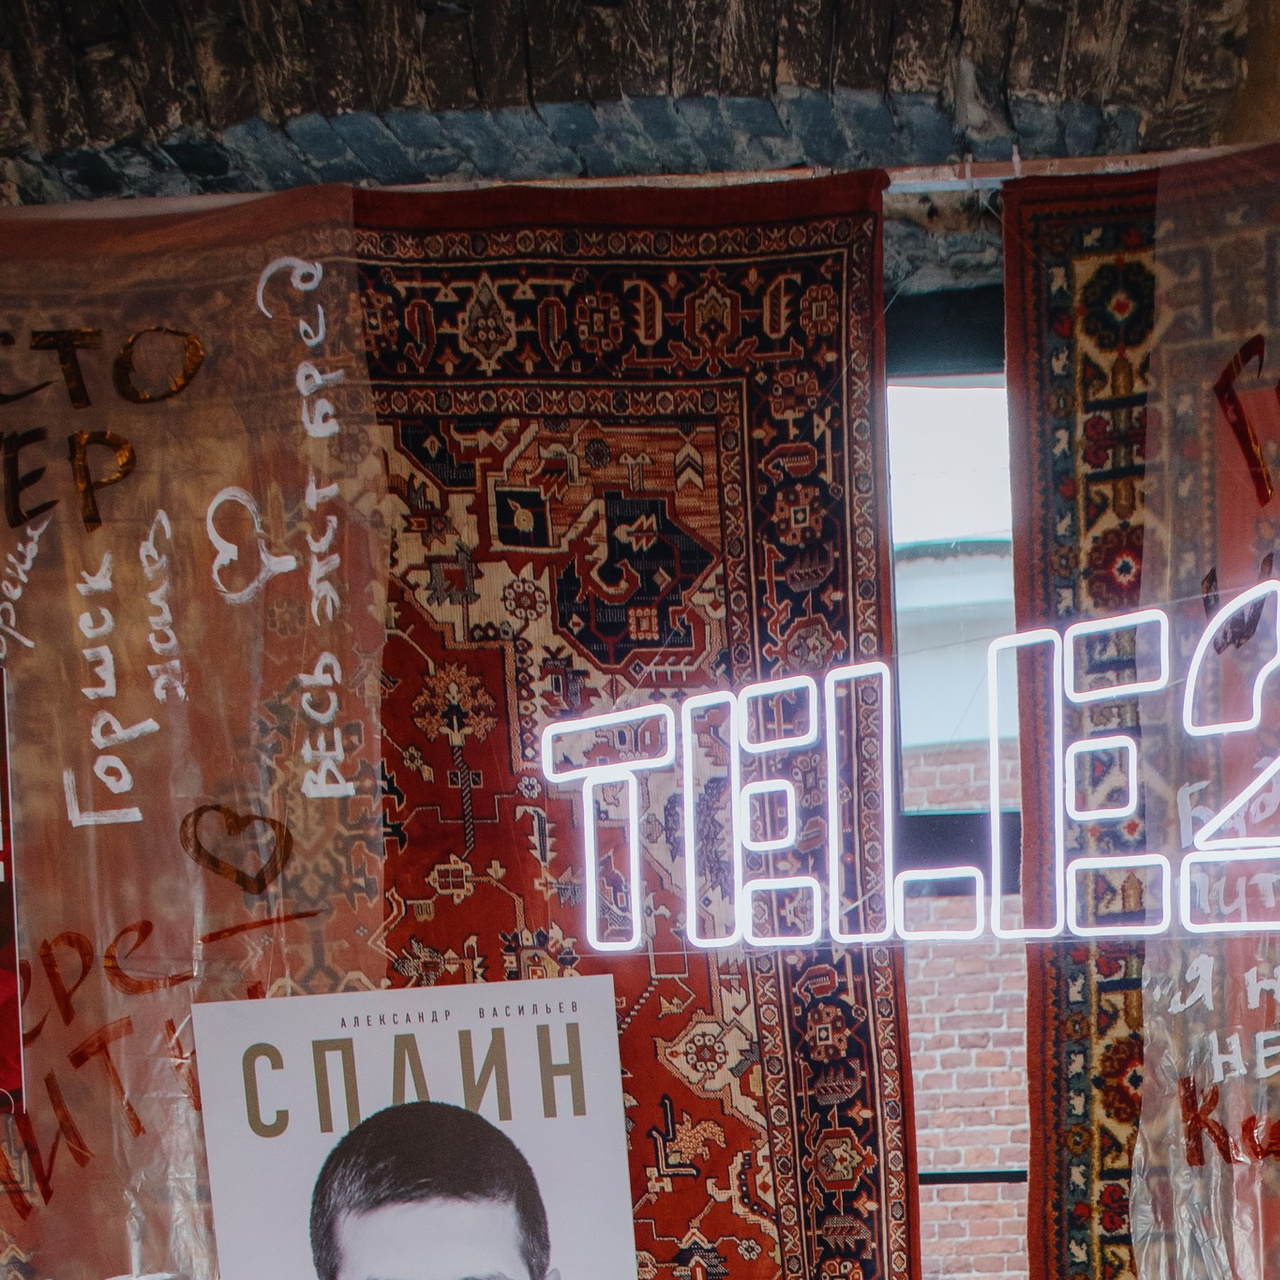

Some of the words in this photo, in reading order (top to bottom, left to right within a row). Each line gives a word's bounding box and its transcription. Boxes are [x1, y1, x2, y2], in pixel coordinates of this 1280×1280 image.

[340, 1009, 452, 1028] АЛЕКСАНДР
[478, 1001, 579, 1019] ВАСИЛЬЕВ
[241, 1022, 587, 1138] СПЛИН
